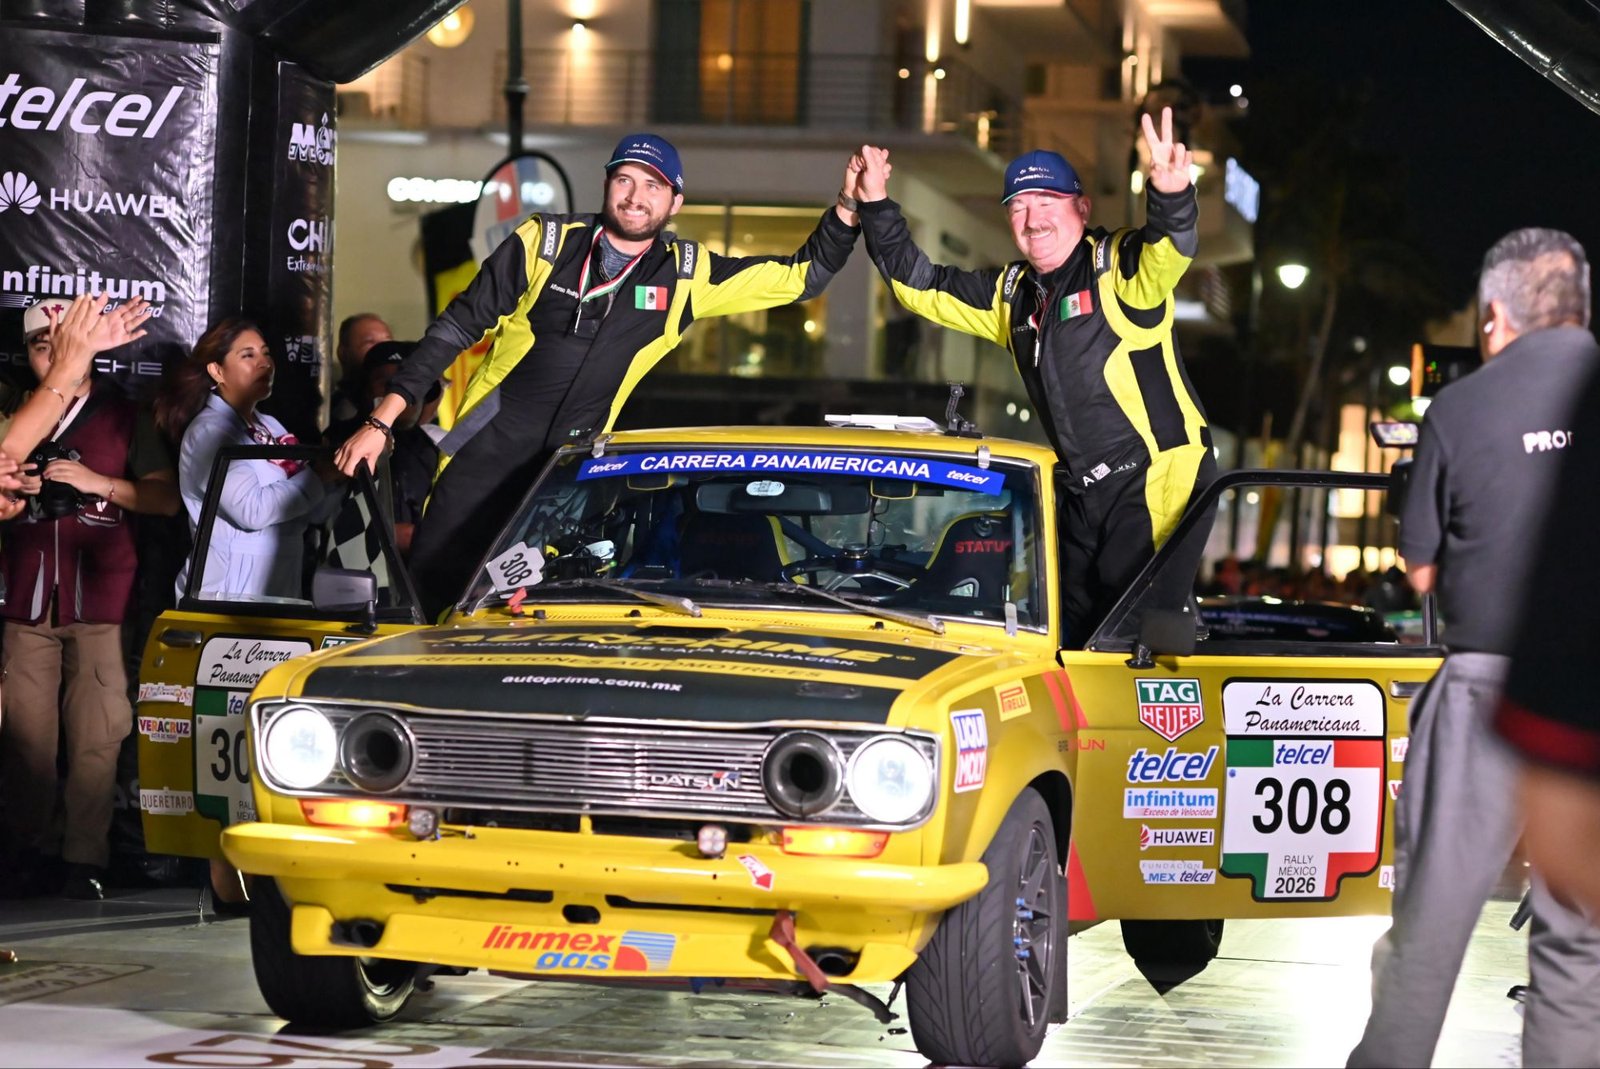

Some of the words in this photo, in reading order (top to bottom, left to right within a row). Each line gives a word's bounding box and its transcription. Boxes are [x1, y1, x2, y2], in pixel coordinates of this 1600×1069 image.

[0, 74, 184, 138] telcel
[50, 188, 179, 218] HUAWEI
[588, 461, 628, 474] telcel
[640, 455, 746, 470] CARRERA
[751, 455, 931, 478] PANAMERICANA
[947, 470, 990, 485] telcel
[500, 552, 532, 586] 308
[222, 641, 242, 660] La
[245, 642, 291, 664] Carrera
[418, 656, 600, 666] REFACCIONES
[502, 674, 683, 692] autoprime.com.mx
[1142, 683, 1196, 702] TAG
[1000, 686, 1026, 713] PIRELLI
[1255, 686, 1282, 707] La
[1290, 686, 1354, 710] Carrera
[139, 719, 190, 734] VERACRUZ
[1143, 706, 1200, 740] HEUER
[210, 728, 249, 784] 30
[1128, 748, 1217, 781] telcel
[1275, 743, 1332, 765] telcel
[957, 750, 987, 788] MOLY
[651, 773, 738, 790] DATSUN
[1127, 790, 1215, 806] infinitum
[1252, 777, 1350, 835] 308
[1143, 808, 1169, 816] Exceso
[1169, 808, 1179, 816] de
[1180, 808, 1214, 816] Velocidad
[1153, 831, 1213, 844] HUAWEI
[1284, 855, 1314, 864] RALLY
[1179, 870, 1213, 882] telcel
[1274, 877, 1316, 894] 2026
[483, 925, 616, 952] linmex
[534, 951, 612, 971] gas
